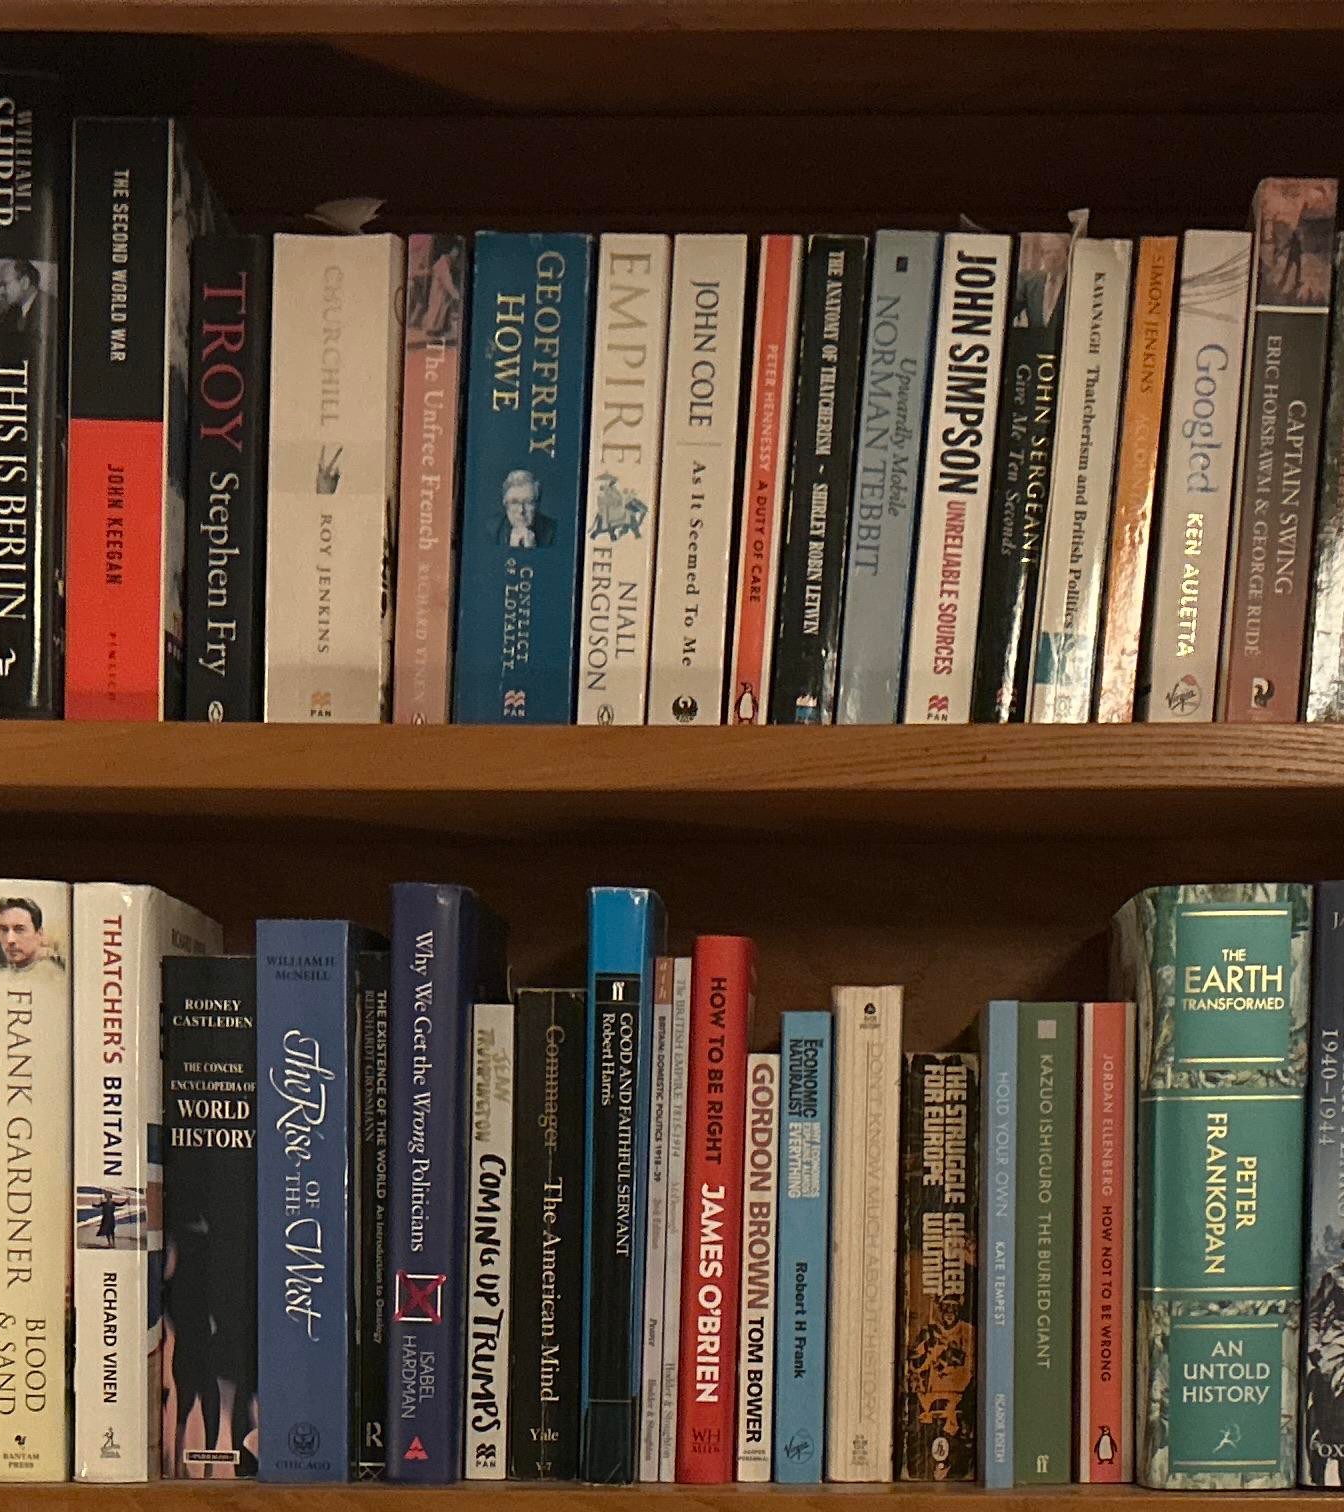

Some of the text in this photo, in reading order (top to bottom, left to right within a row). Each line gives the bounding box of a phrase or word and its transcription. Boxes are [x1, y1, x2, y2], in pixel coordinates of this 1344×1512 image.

[200, 272, 246, 454] TROY
[492, 293, 525, 412] HOWE
[529, 251, 566, 458] GEOFFREY
[599, 251, 651, 467] EMPIRE
[938, 249, 998, 495] JOHN SIMPSON
[198, 470, 239, 678] Stephen Fry
[586, 547, 612, 691] FERGUSON
[615, 580, 637, 660] NIALL
[185, 999, 242, 1013] RODNEY
[1182, 996, 1284, 1011] TRANSFORMED
[1184, 965, 1282, 992] EARTH
[1222, 948, 1246, 962] THE
[173, 1015, 253, 1028] CASTLEDEN
[5, 990, 33, 1288] FRANK GARDNER
[103, 1077, 122, 1177] BRITAIN
[170, 1127, 255, 1149] HISTORY
[177, 1100, 250, 1121] WORLD
[409, 930, 434, 1253] Why We Get the Wrong Politicians
[701, 1185, 726, 1278] JAMES
[1204, 1112, 1228, 1275] FRANKOPAN
[1237, 1156, 1257, 1230] PETER
[471, 1154, 506, 1433] COMING UP TRUMPS
